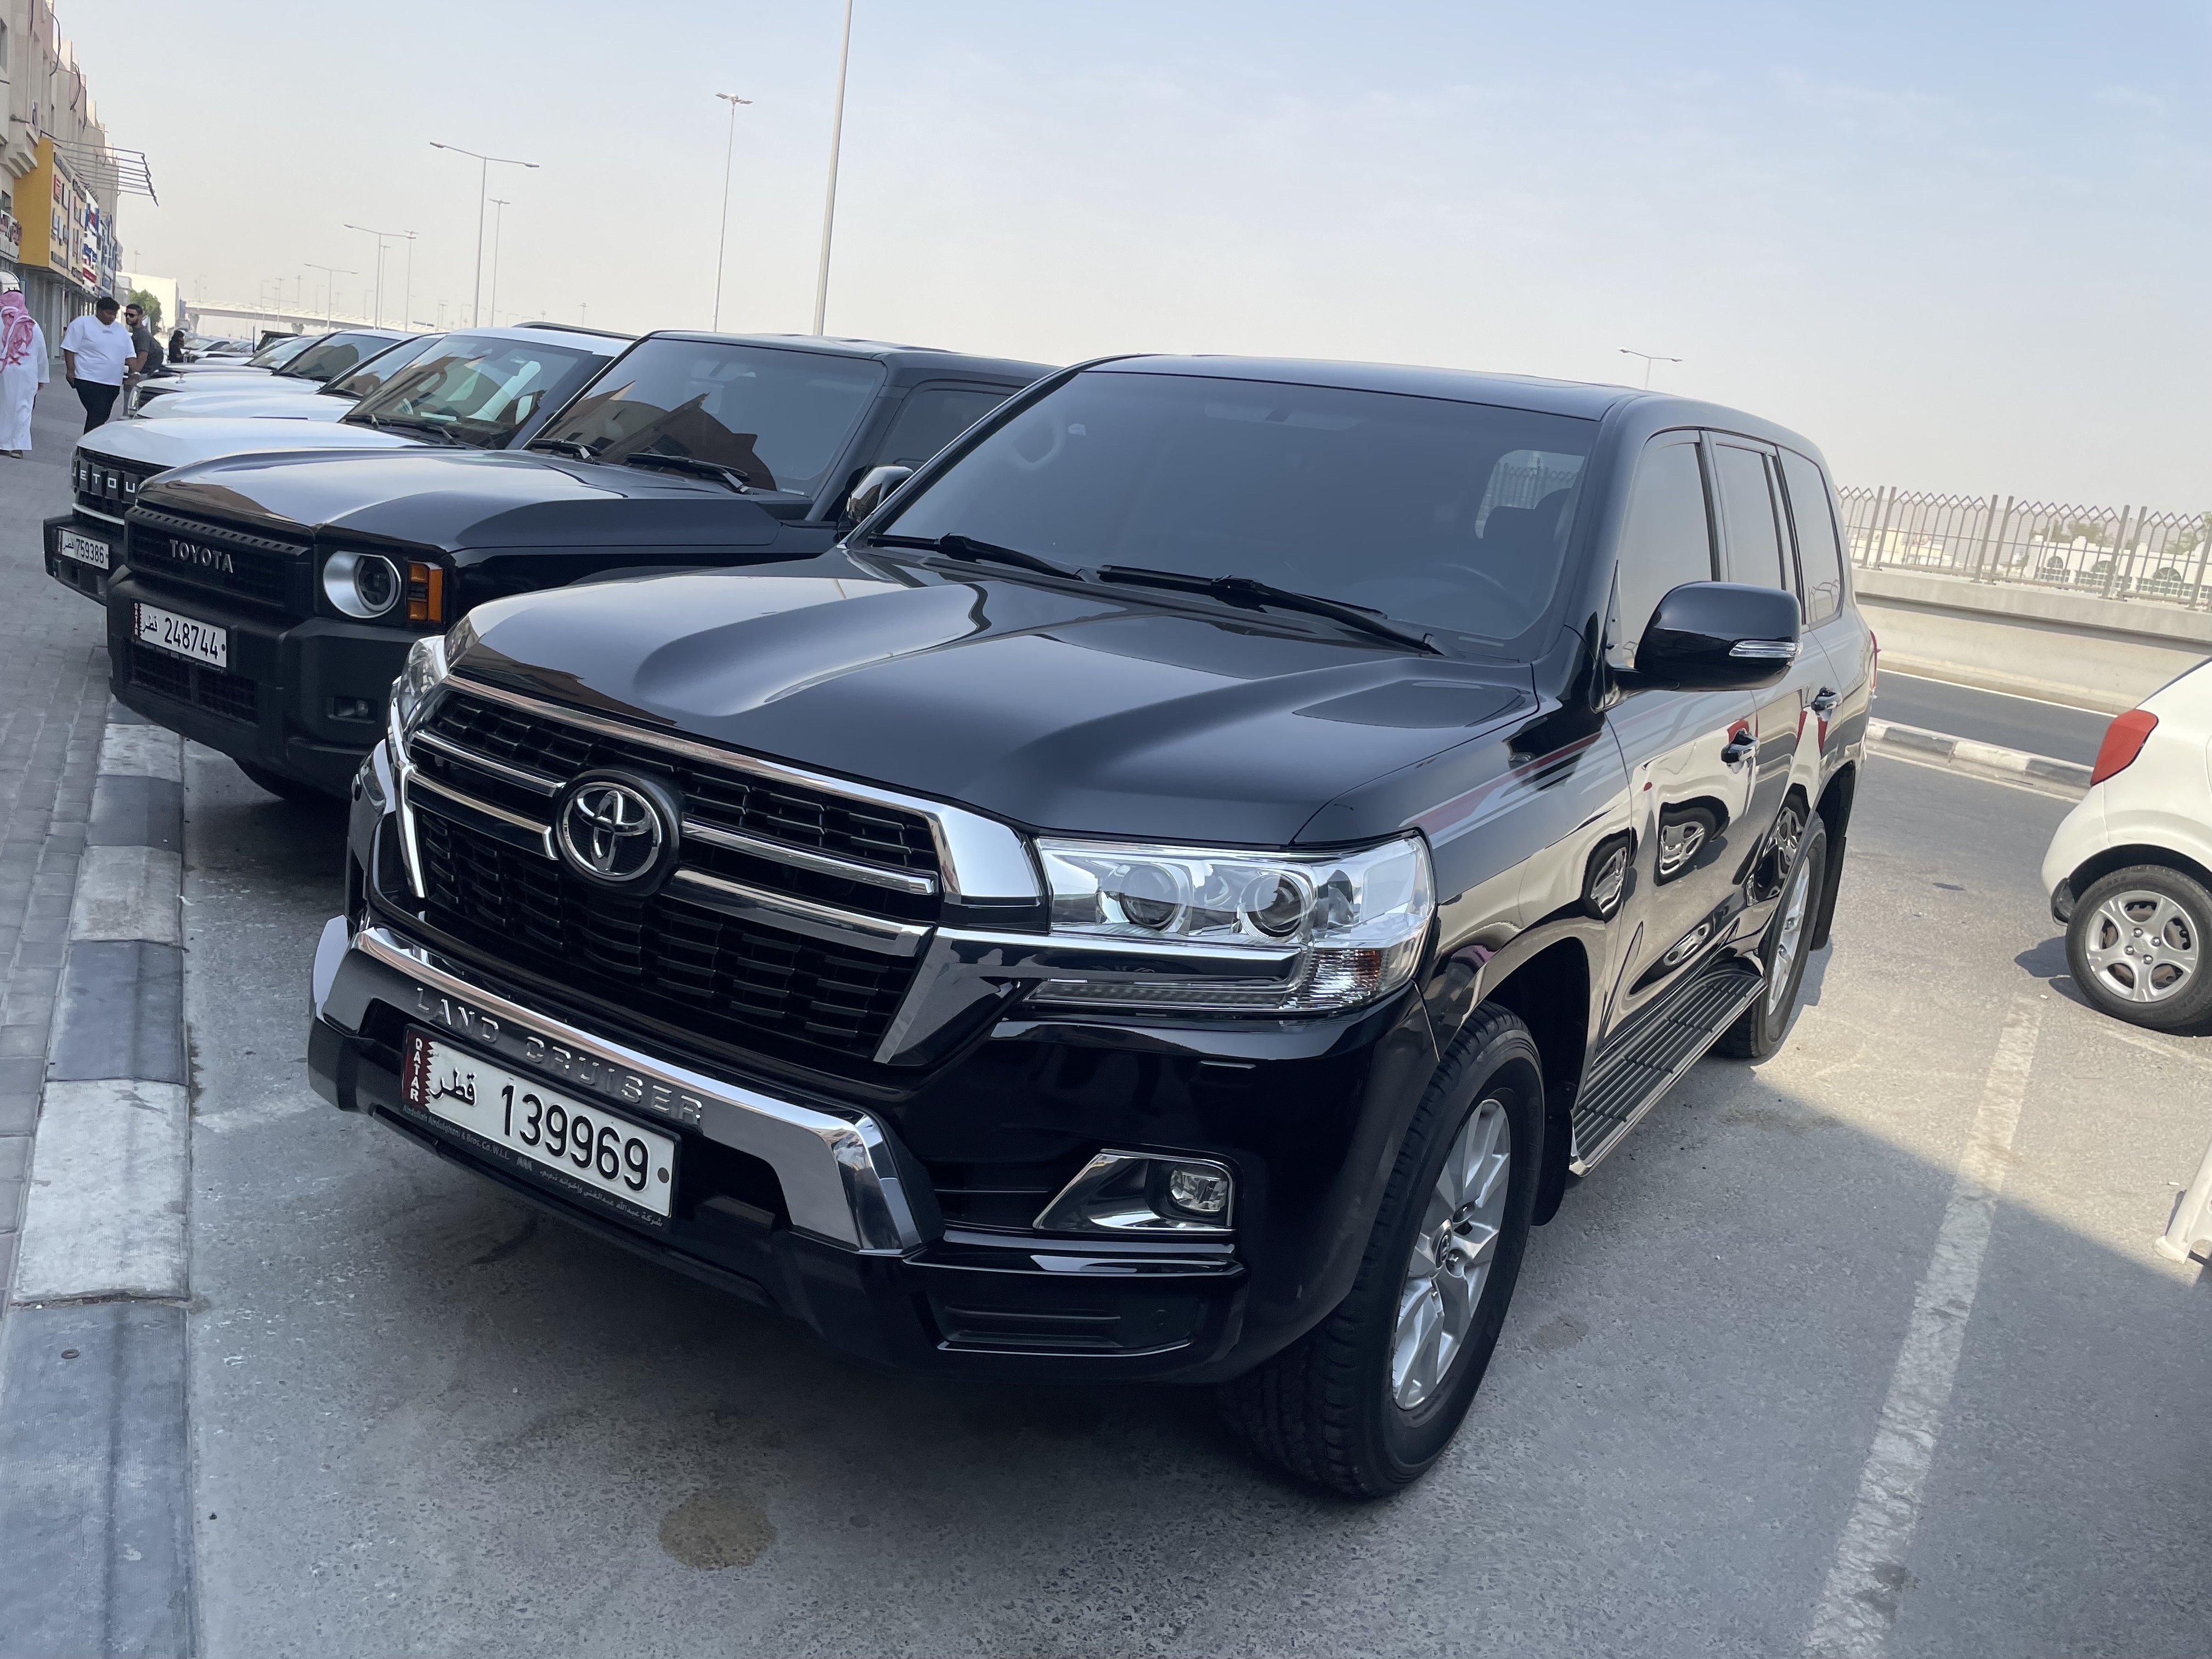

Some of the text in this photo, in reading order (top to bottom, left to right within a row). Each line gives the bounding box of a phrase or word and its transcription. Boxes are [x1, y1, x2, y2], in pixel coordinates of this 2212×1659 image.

[71, 467, 136, 493] JETOU
[76, 538, 104, 563] 759386
[170, 539, 233, 573] TOYOTA
[140, 614, 218, 660] قطر 248744
[410, 1037, 422, 1102] QATAR
[417, 987, 702, 1125] LAND CRUISER
[403, 1104, 427, 1122] Abdullah
[428, 1116, 460, 1137] Abdulghani
[430, 1067, 649, 1191] قطر 139969
[641, 1211, 663, 1227] شركة
